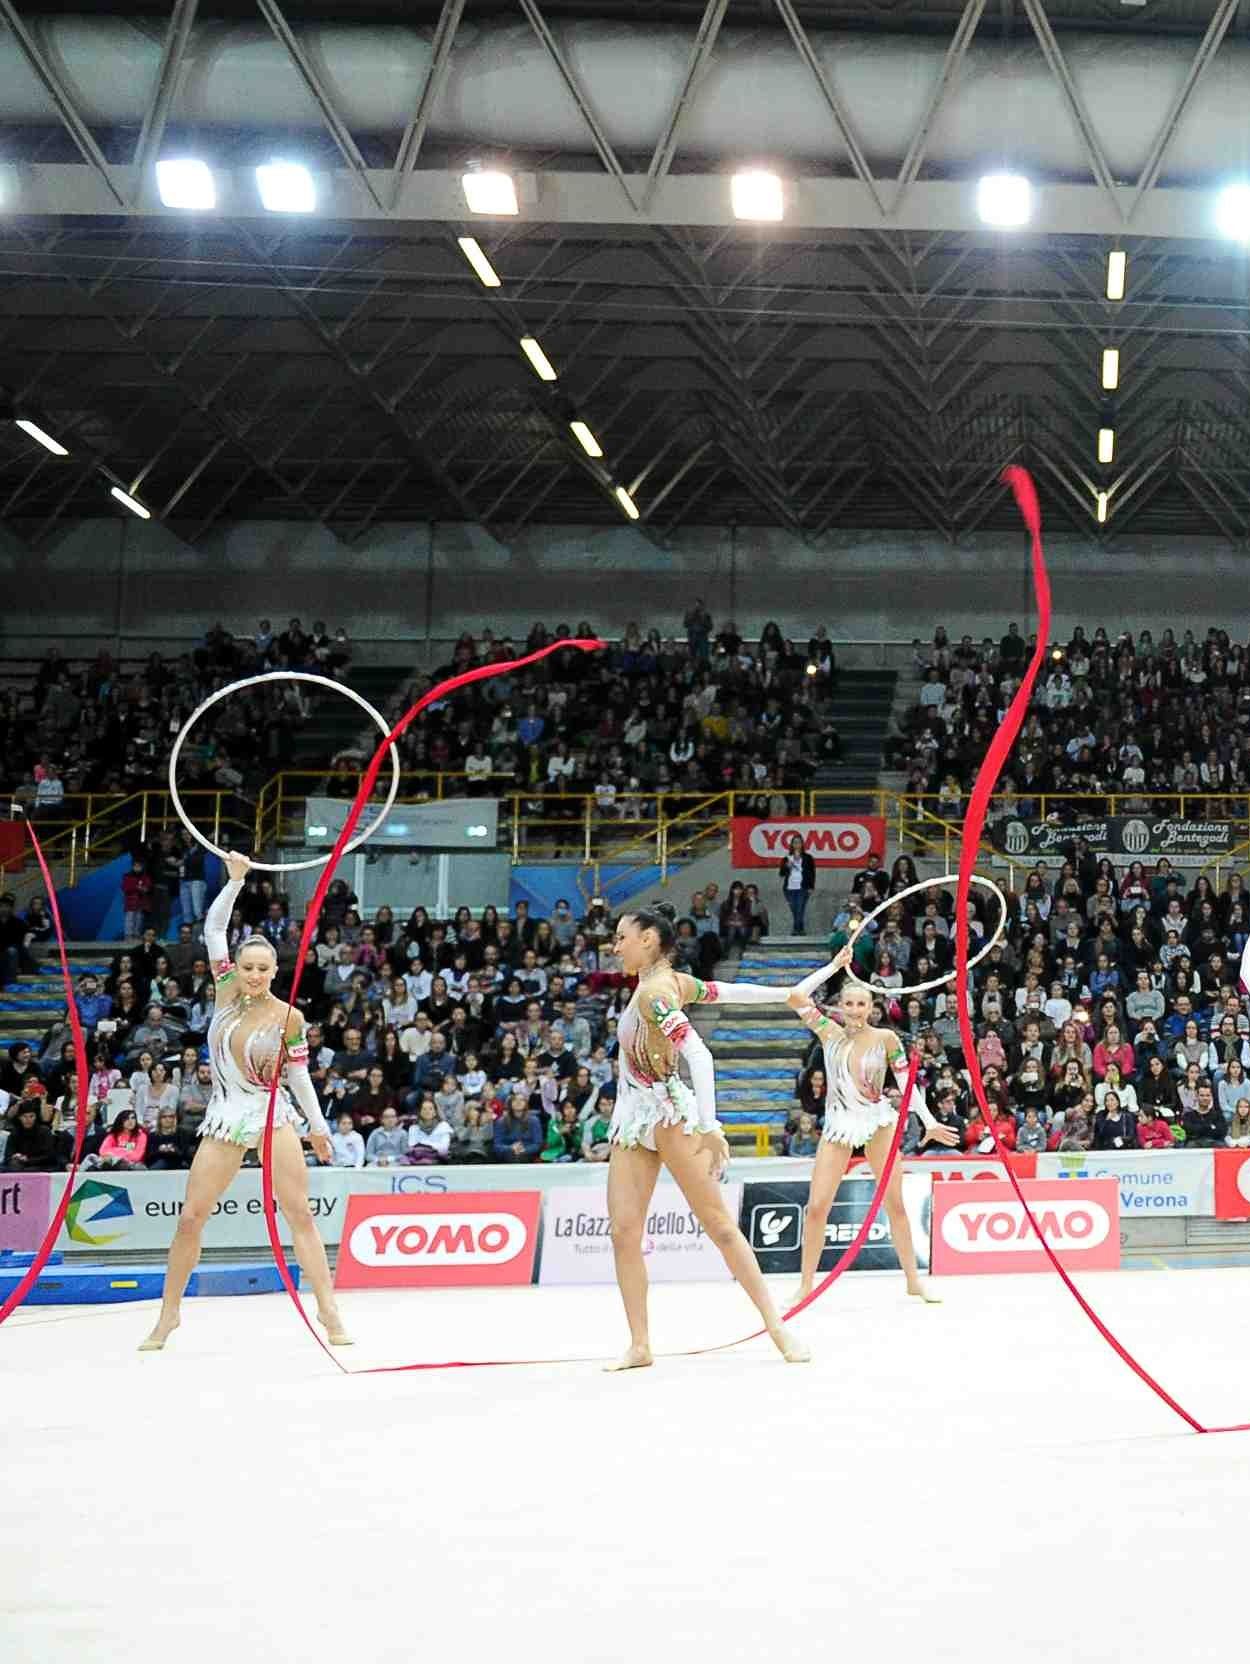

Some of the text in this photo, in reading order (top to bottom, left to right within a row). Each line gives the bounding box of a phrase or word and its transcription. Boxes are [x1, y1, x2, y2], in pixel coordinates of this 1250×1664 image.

[761, 830, 860, 851] YOMO
[1120, 1191, 1188, 1208] Verona
[959, 1210, 1094, 1241] YOMO
[370, 1223, 510, 1255] YOMO
